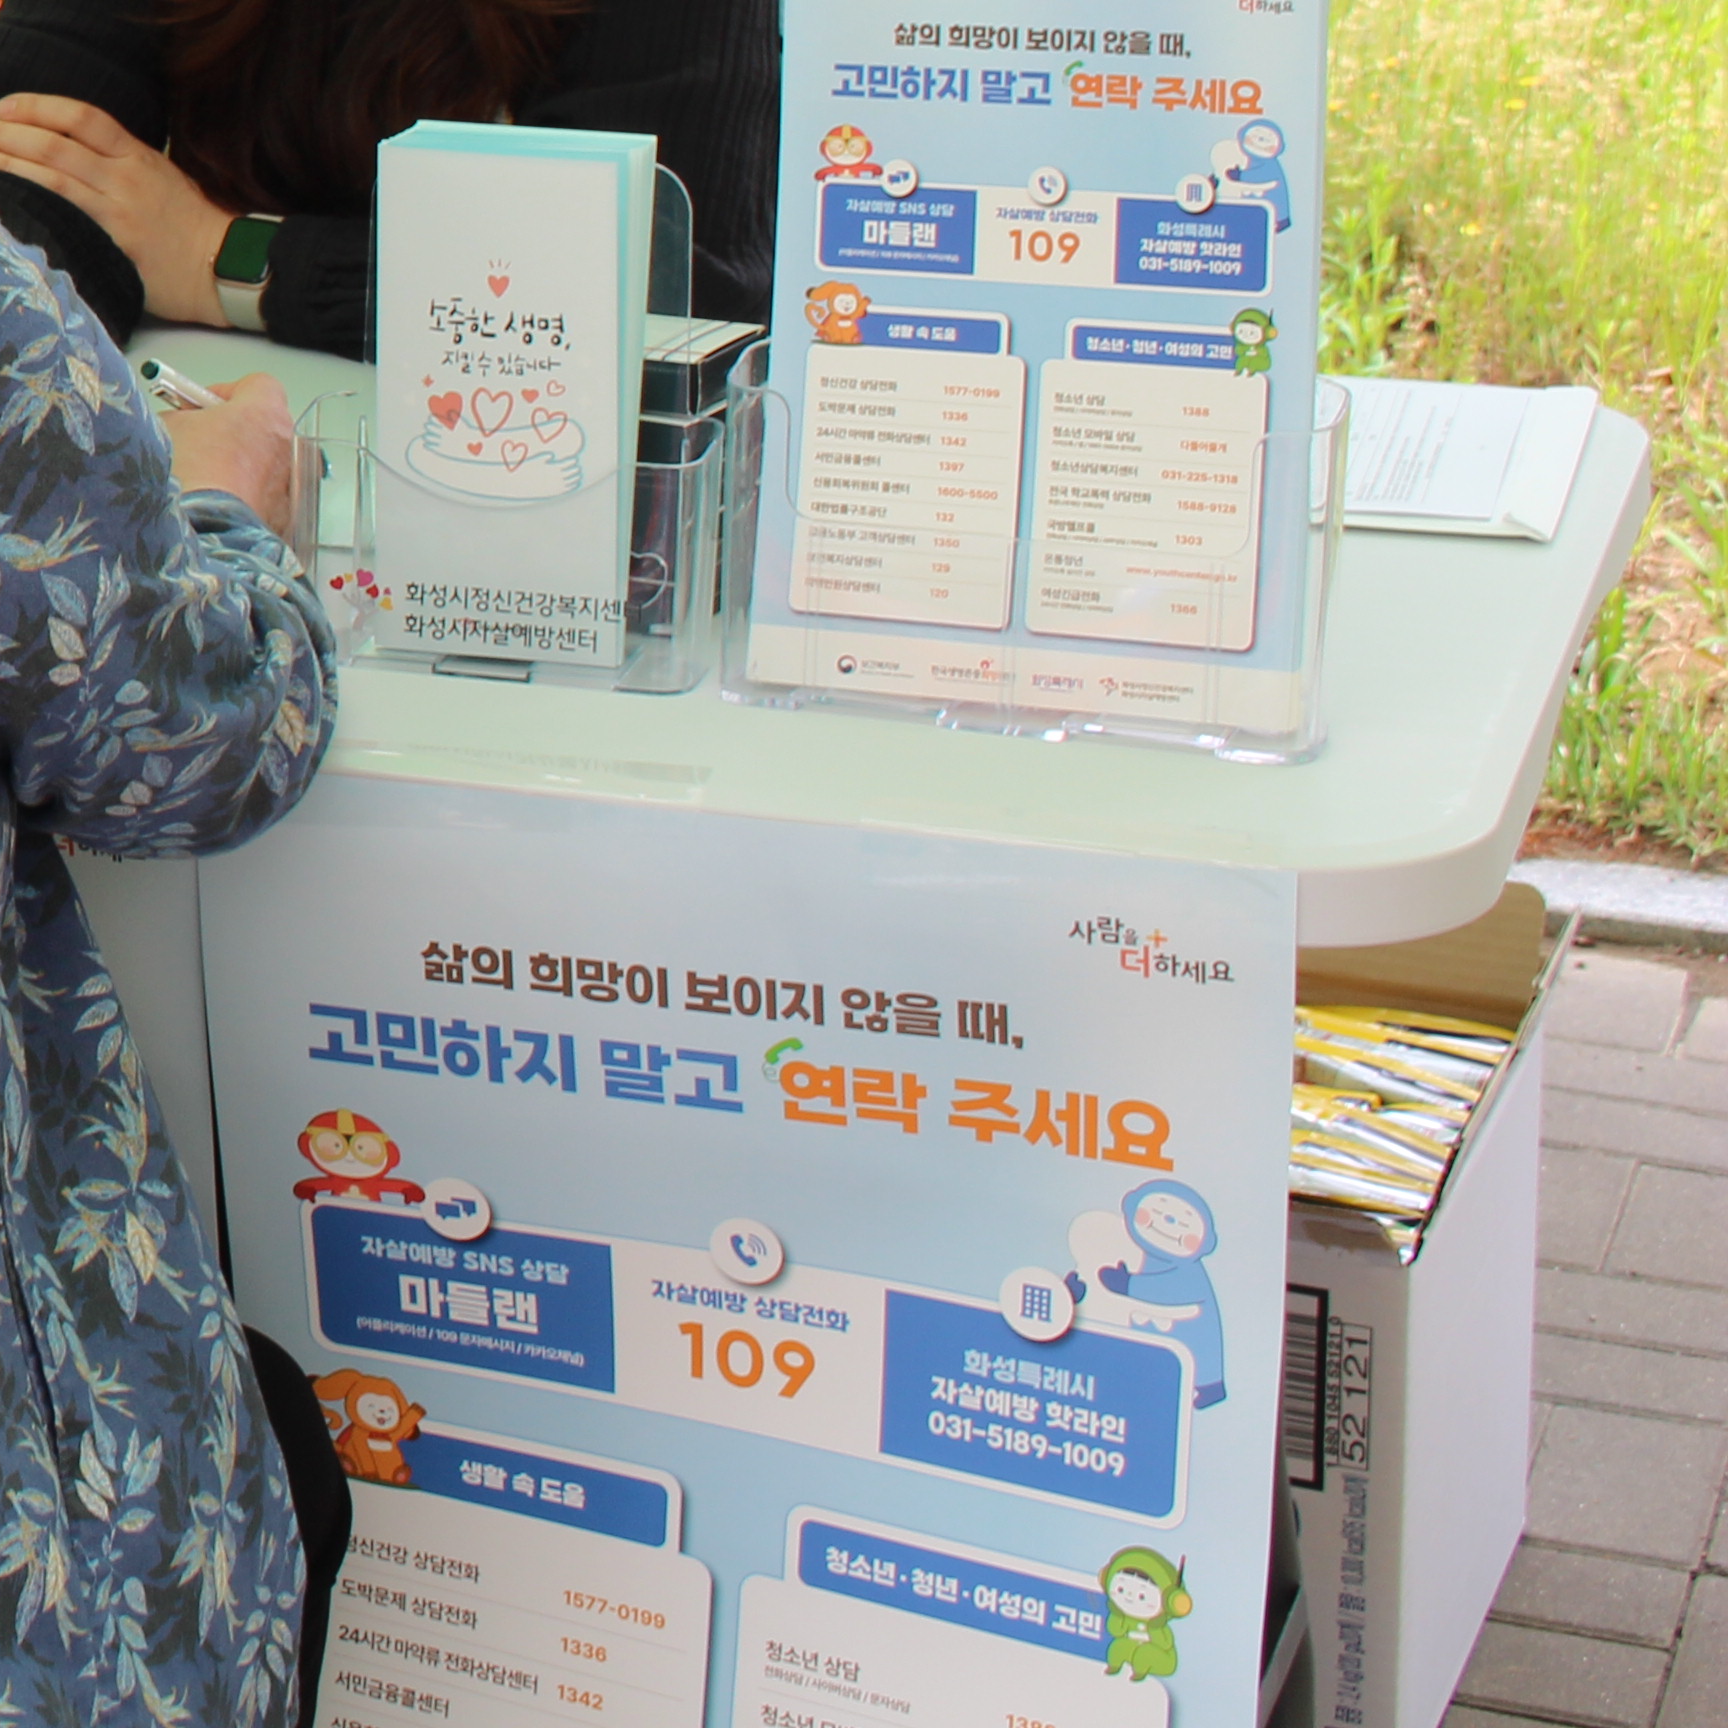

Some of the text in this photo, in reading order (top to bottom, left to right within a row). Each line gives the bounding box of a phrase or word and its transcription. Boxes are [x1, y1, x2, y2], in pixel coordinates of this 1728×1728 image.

[895, 23, 1192, 59] 삶의 희망이 보이지 않을 때,
[832, 63, 1264, 115] 고민하지 말고 연락 주세요
[899, 203, 927, 216] SNS
[1008, 229, 1081, 264] 109
[1139, 258, 1242, 276] 031-5189-1009
[429, 297, 495, 346] 소중한
[941, 436, 967, 447] 1342
[936, 512, 955, 522] 132
[1068, 916, 1138, 946] 사람을
[1120, 944, 1235, 985] 더하세요
[421, 940, 1025, 1050] 삶의 희망이 보이지 않을 때,
[308, 1002, 1175, 1172] 고민하지 말고 연락 주세요
[360, 1235, 570, 1286] 자살예방 SNS 상담
[398, 1273, 540, 1335] 마들랜
[651, 1279, 850, 1334] 자살예방 상담전화
[678, 1320, 817, 1401] 109
[963, 1347, 1095, 1402] 화성특례시
[1343, 1335, 1369, 1395] 121
[931, 1376, 1127, 1444] 자살예방 핫라인
[927, 1409, 1126, 1478] 031-5189-1009
[1341, 1413, 1367, 1463] 52
[459, 1458, 587, 1510] 생활 속 도움
[413, 1546, 480, 1584] 상담전화
[341, 1578, 478, 1631] 도박문제 상담전화
[562, 1589, 667, 1631] 1577-0199
[1052, 1606, 1102, 1641] 고민
[338, 1624, 540, 1696] 24시간 마약류 전화상담센터
[559, 1636, 608, 1663] 1336
[765, 1639, 861, 1682] 청소년 상담
[335, 1671, 451, 1719] 서민금융콜센터
[556, 1683, 605, 1711] 1342
